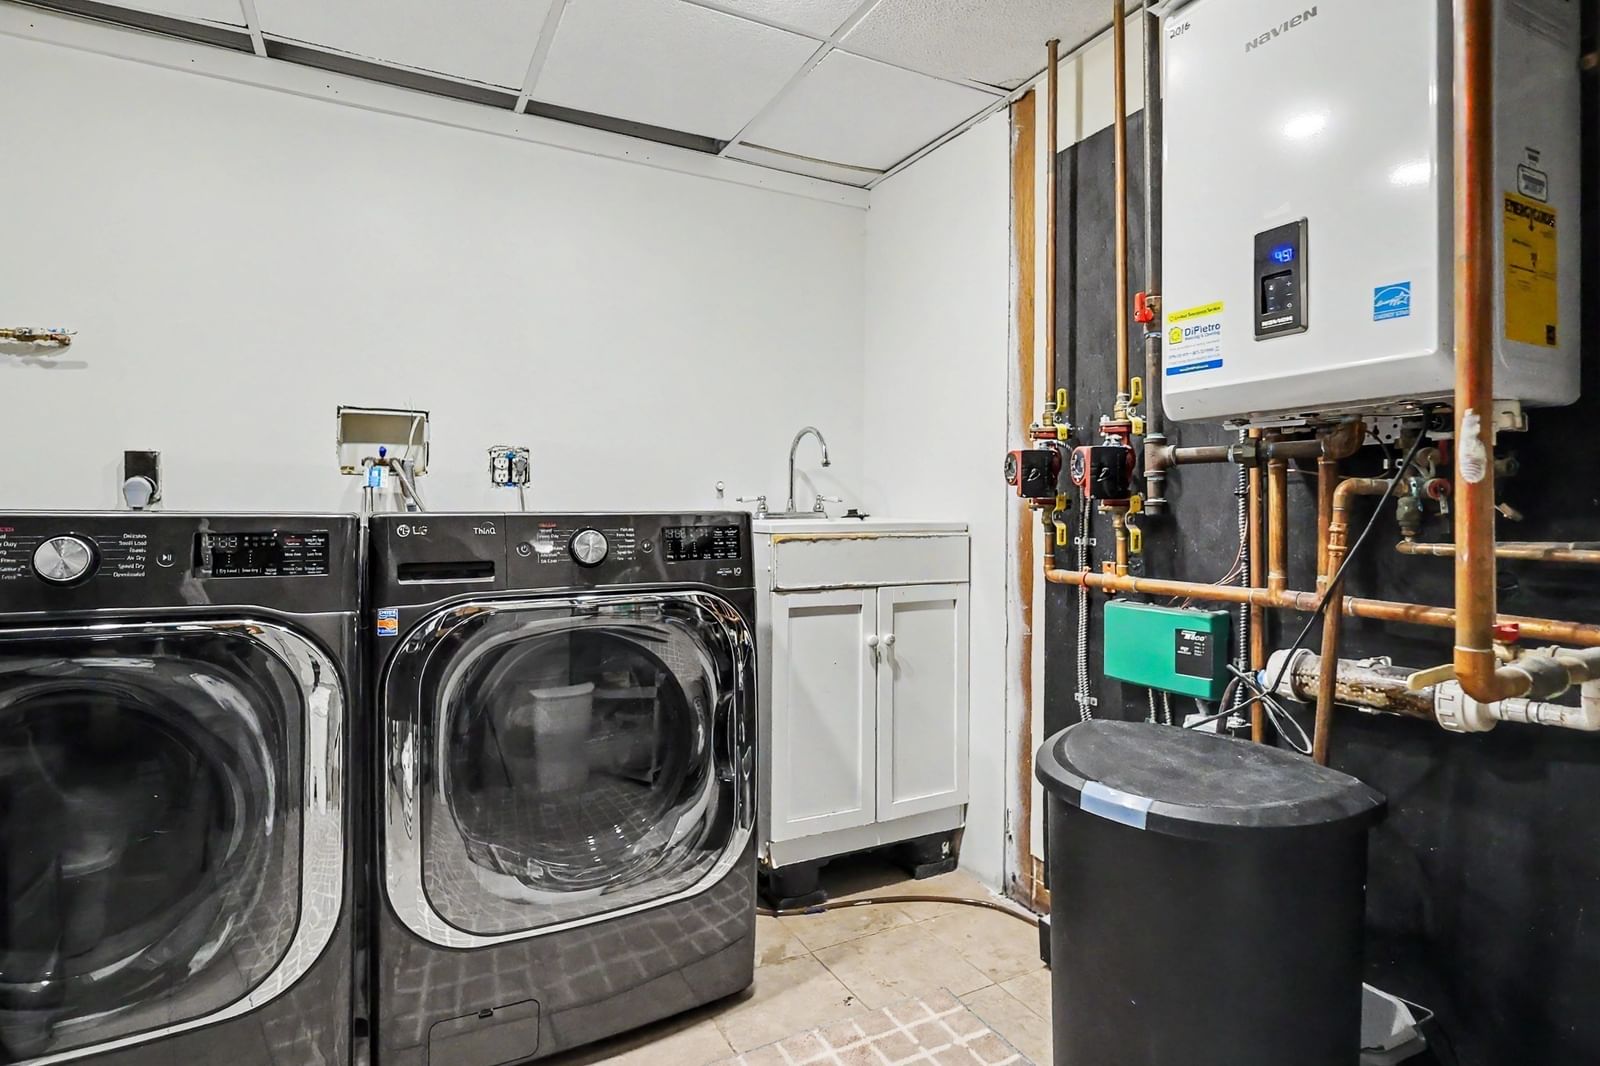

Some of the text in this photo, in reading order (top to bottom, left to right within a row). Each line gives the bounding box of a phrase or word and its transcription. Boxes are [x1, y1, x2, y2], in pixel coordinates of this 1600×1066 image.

[1169, 21, 1191, 39] 2016
[1184, 323, 1221, 337] DiPietro
[412, 525, 428, 536] LG
[472, 527, 497, 535] ThinQ
